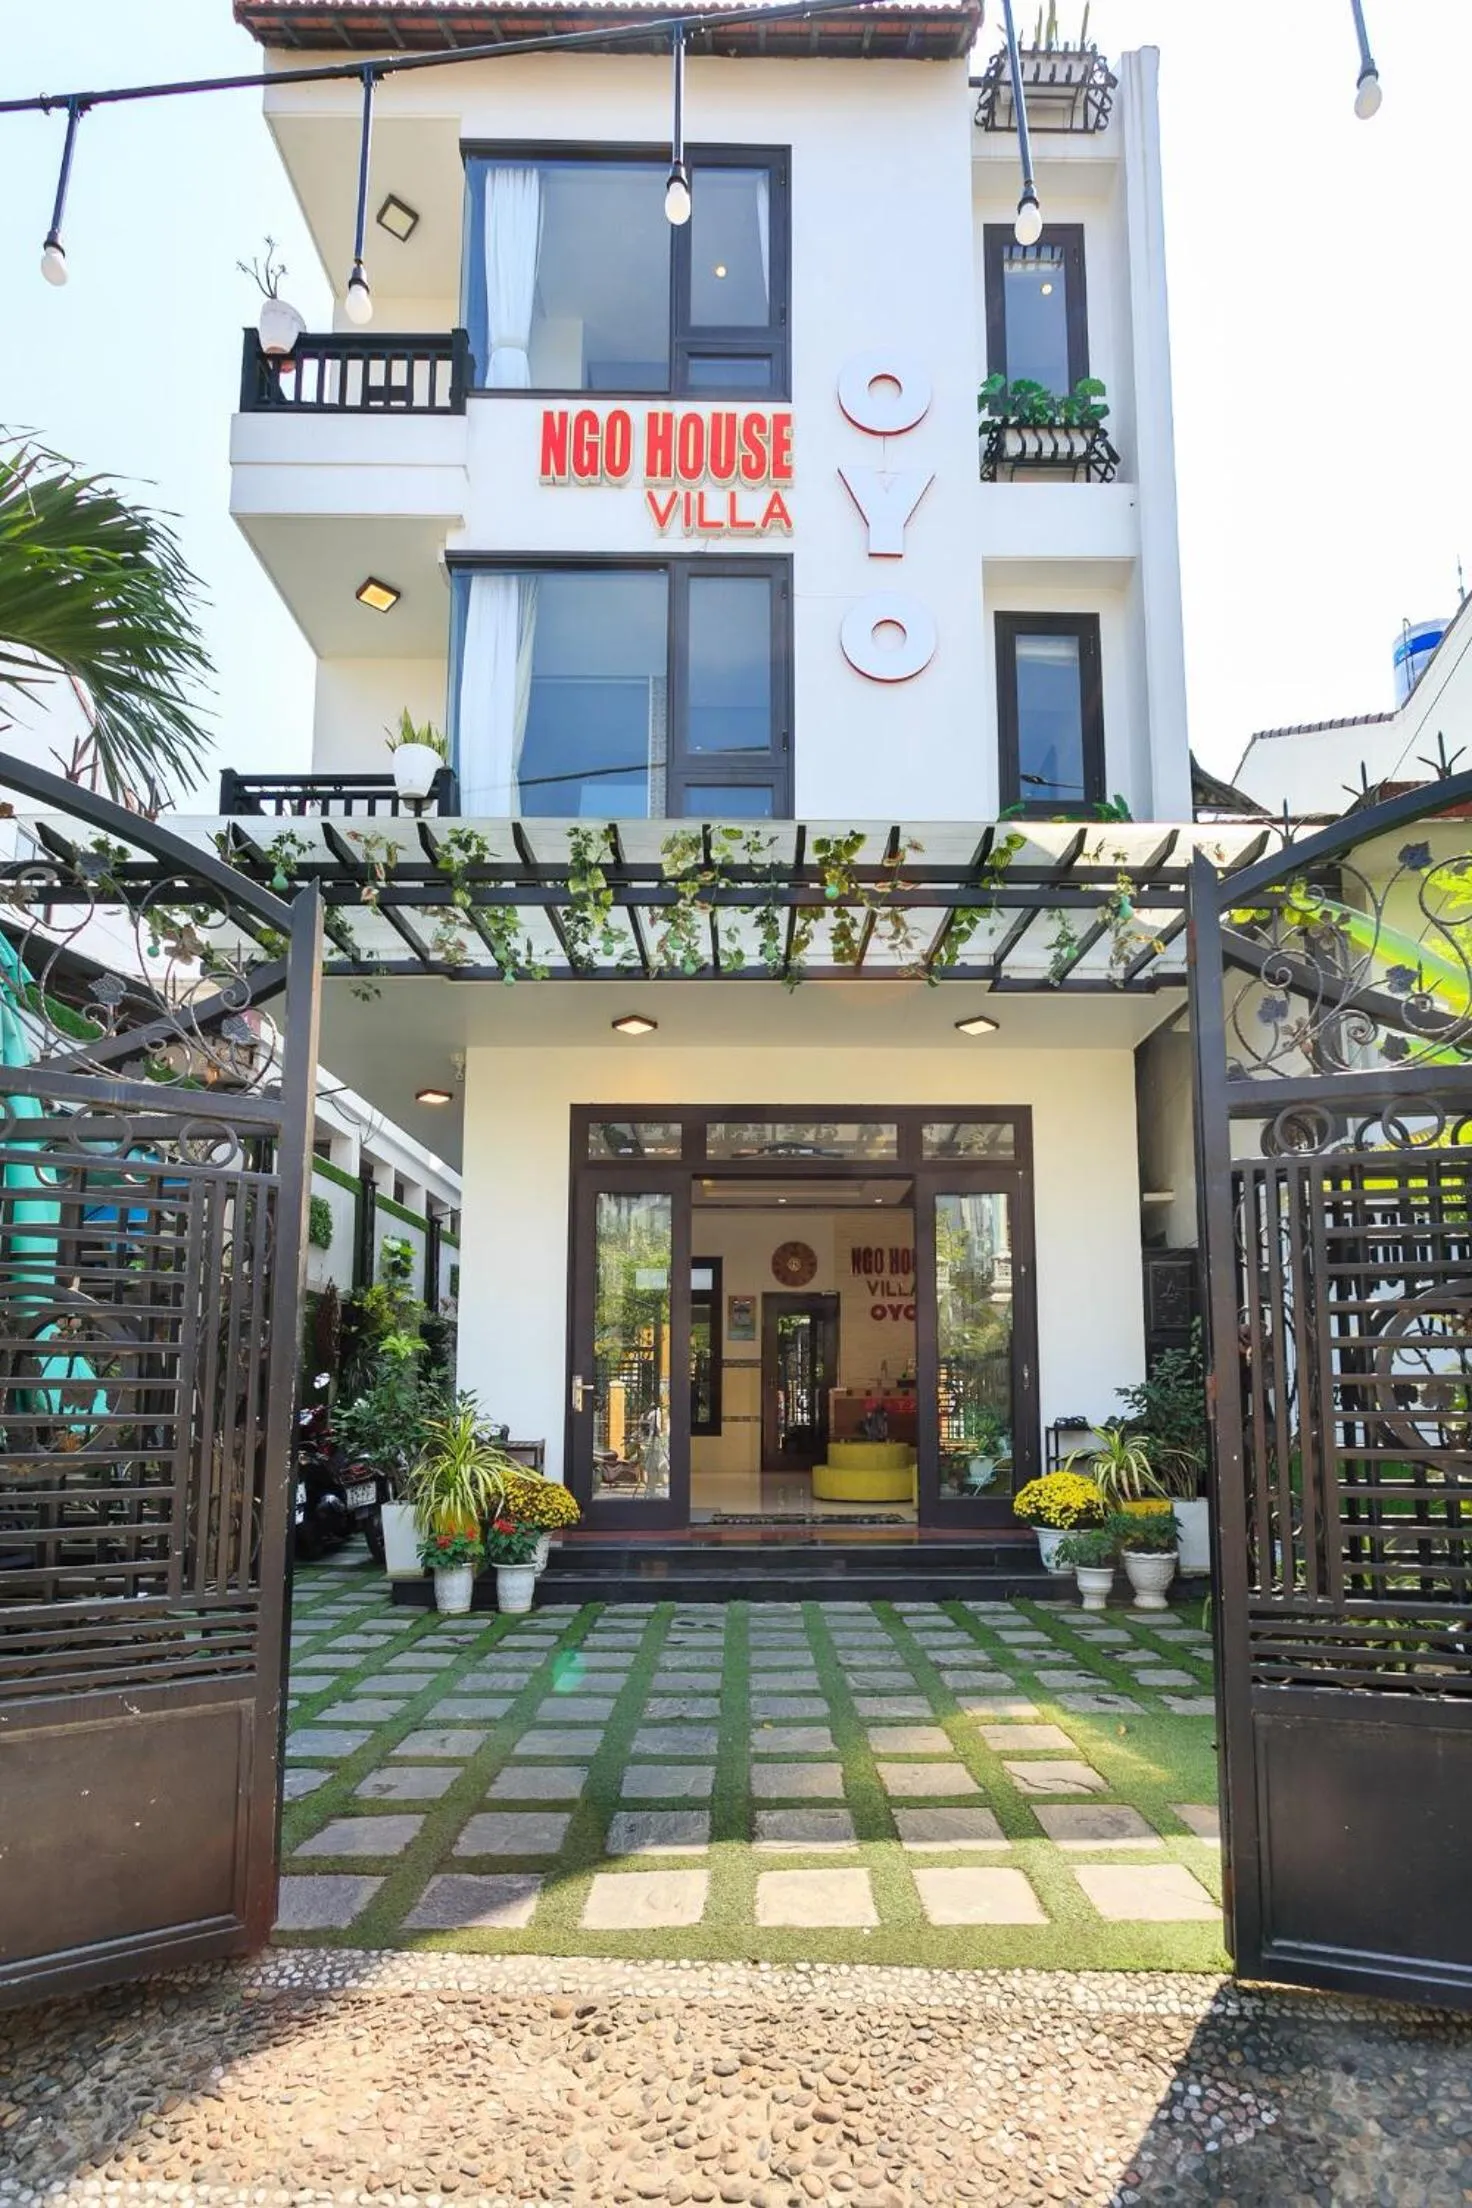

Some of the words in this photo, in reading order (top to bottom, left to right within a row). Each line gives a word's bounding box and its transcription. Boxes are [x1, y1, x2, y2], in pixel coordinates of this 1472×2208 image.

[539, 409, 634, 484] NGO
[643, 411, 794, 486] HOUSE
[646, 489, 794, 536] VILLA
[837, 347, 937, 683] OYO
[851, 1246, 884, 1275] NGO
